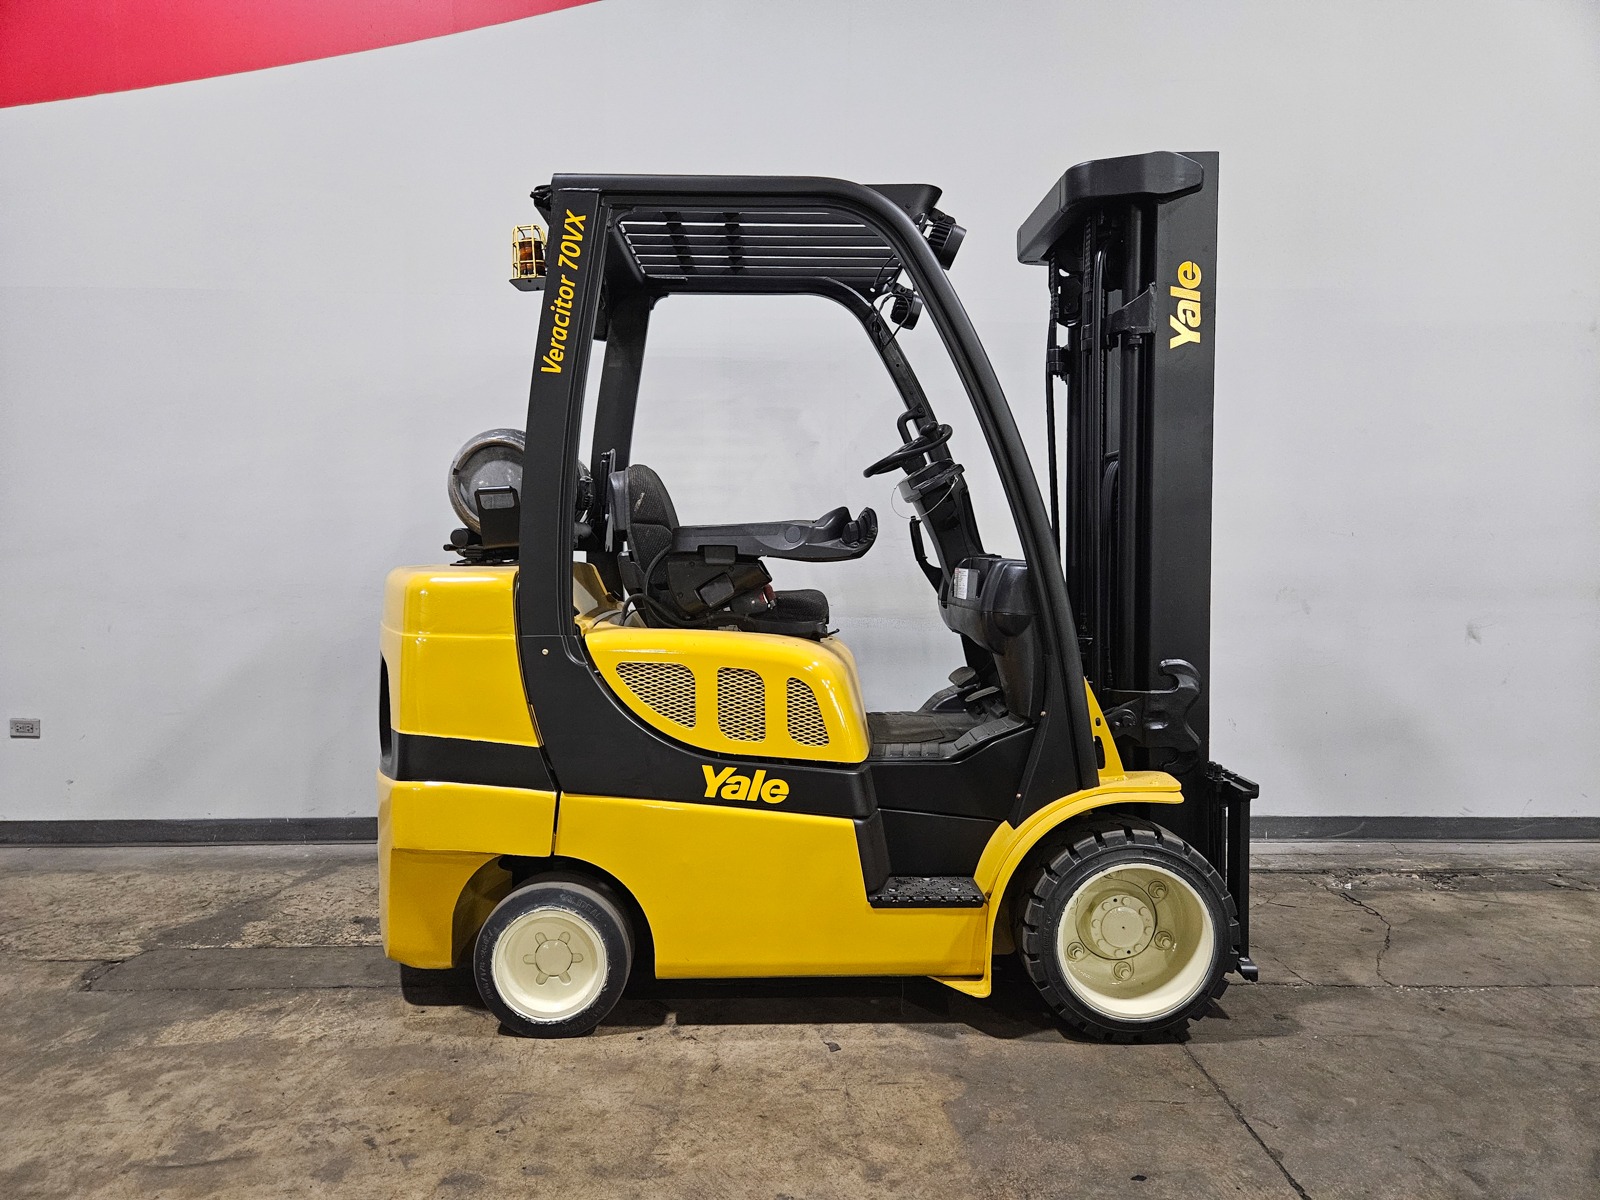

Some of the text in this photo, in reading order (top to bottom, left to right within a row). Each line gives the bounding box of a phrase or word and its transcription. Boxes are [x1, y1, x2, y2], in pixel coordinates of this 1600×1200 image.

[540, 208, 588, 374] Veracitor 70VX
[1169, 260, 1202, 350] Yale
[701, 764, 790, 804] Yale
